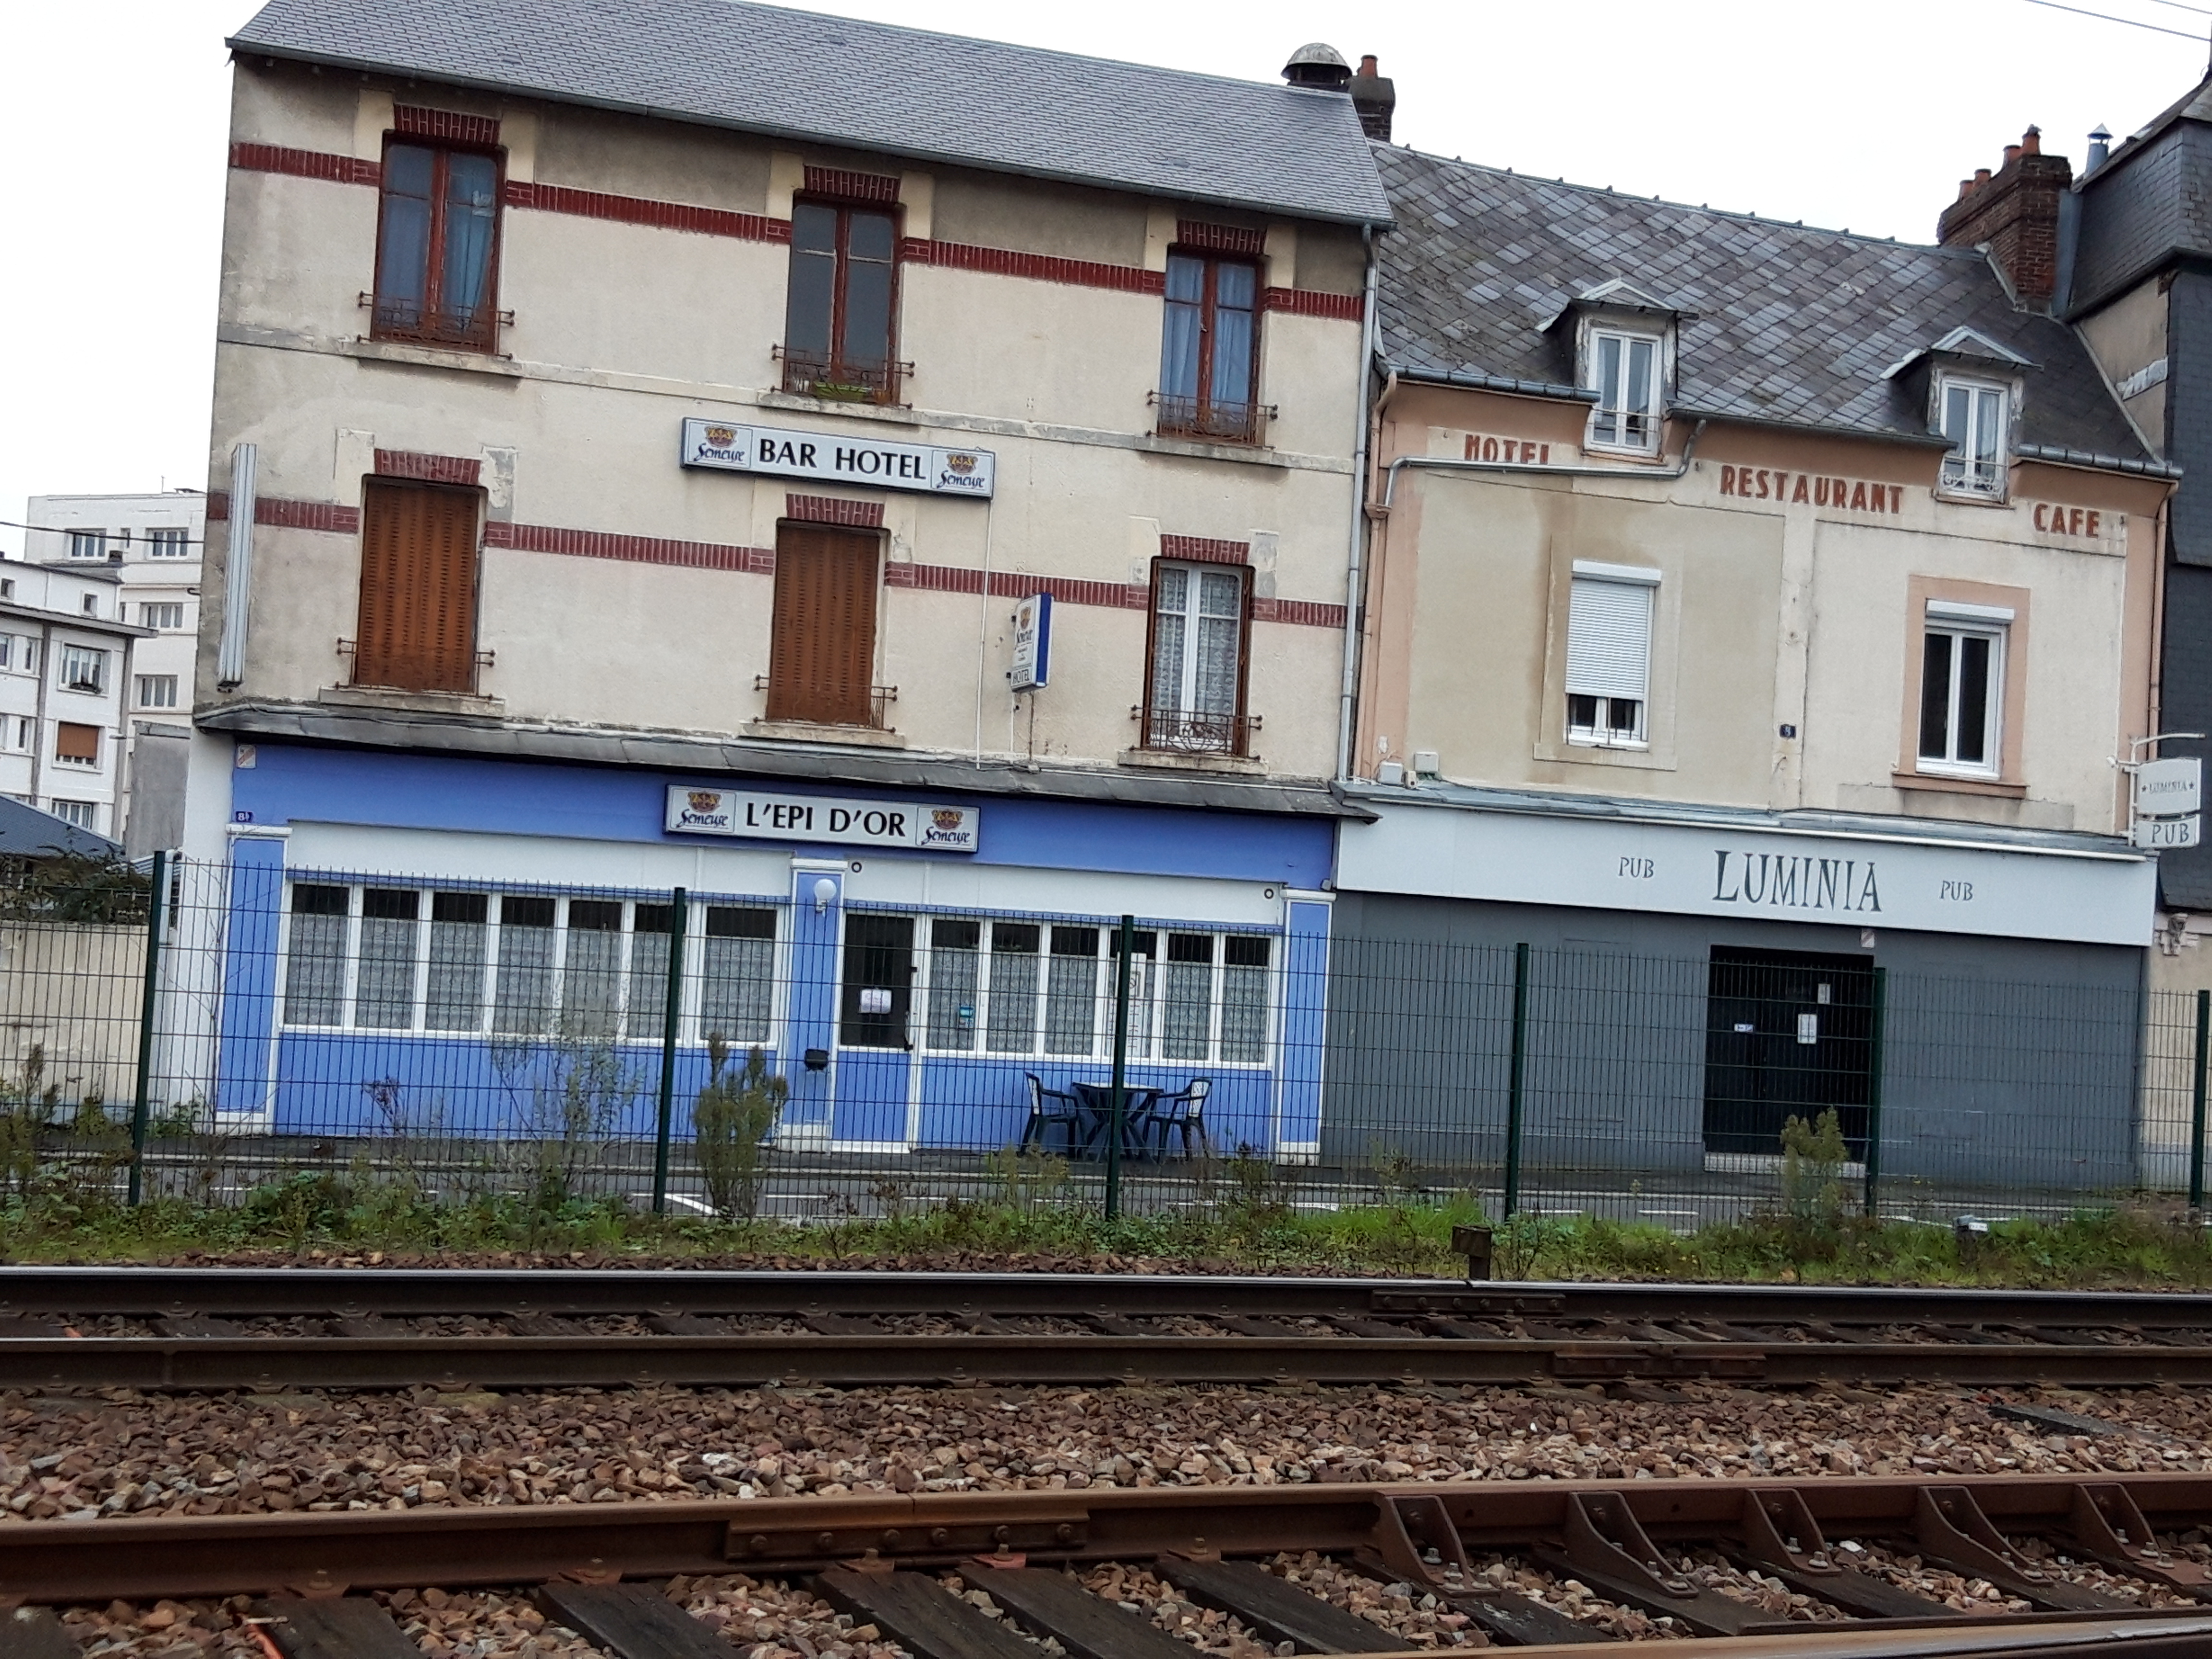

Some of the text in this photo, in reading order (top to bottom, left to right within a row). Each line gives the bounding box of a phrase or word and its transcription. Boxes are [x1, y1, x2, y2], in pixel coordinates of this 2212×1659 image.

[759, 438, 926, 480] BAR HOTEL
[1719, 465, 1903, 514] RESTAURANT
[2033, 504, 2099, 538] CAFE
[746, 802, 905, 837] L'EPI D'OR
[2152, 823, 2189, 844] PUB
[1619, 857, 1655, 878] PUB
[1712, 850, 1883, 913] LUMINIA
[1940, 880, 1973, 902] PUB
